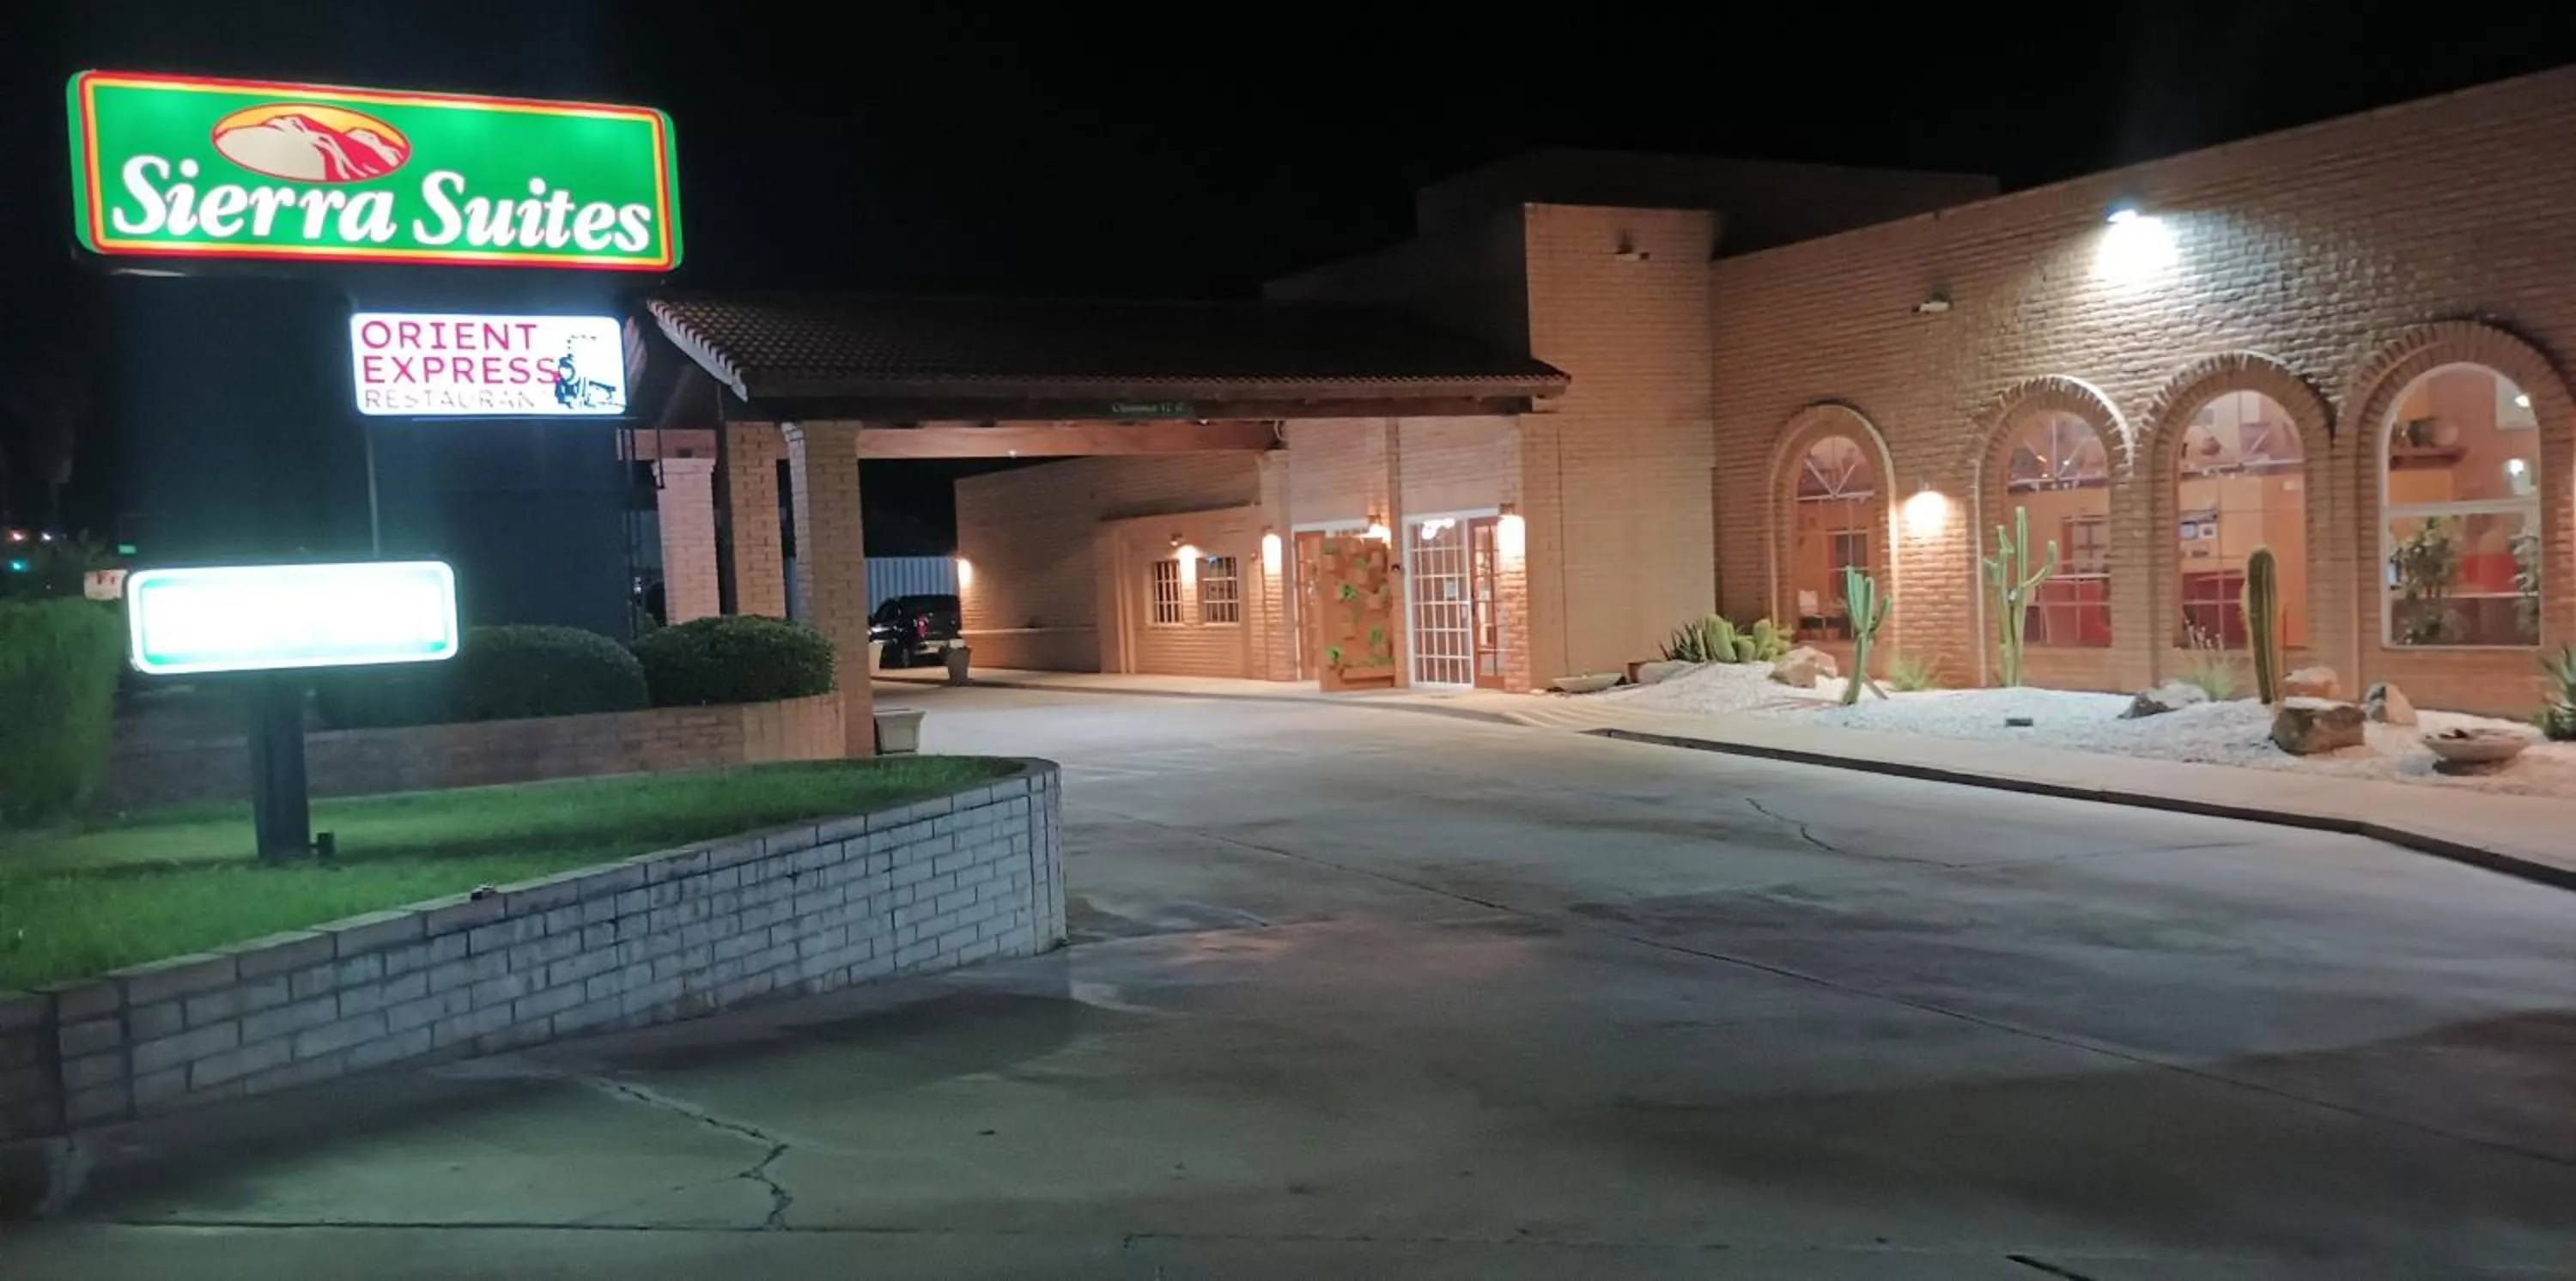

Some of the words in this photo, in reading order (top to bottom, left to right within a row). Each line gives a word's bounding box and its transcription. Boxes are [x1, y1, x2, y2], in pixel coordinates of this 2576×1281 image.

[112, 155, 398, 243] Sierra
[413, 171, 651, 252] Suites
[361, 320, 538, 350] ORIENT
[363, 355, 561, 384] EXPRESS
[364, 389, 550, 410] RESTAURAN
